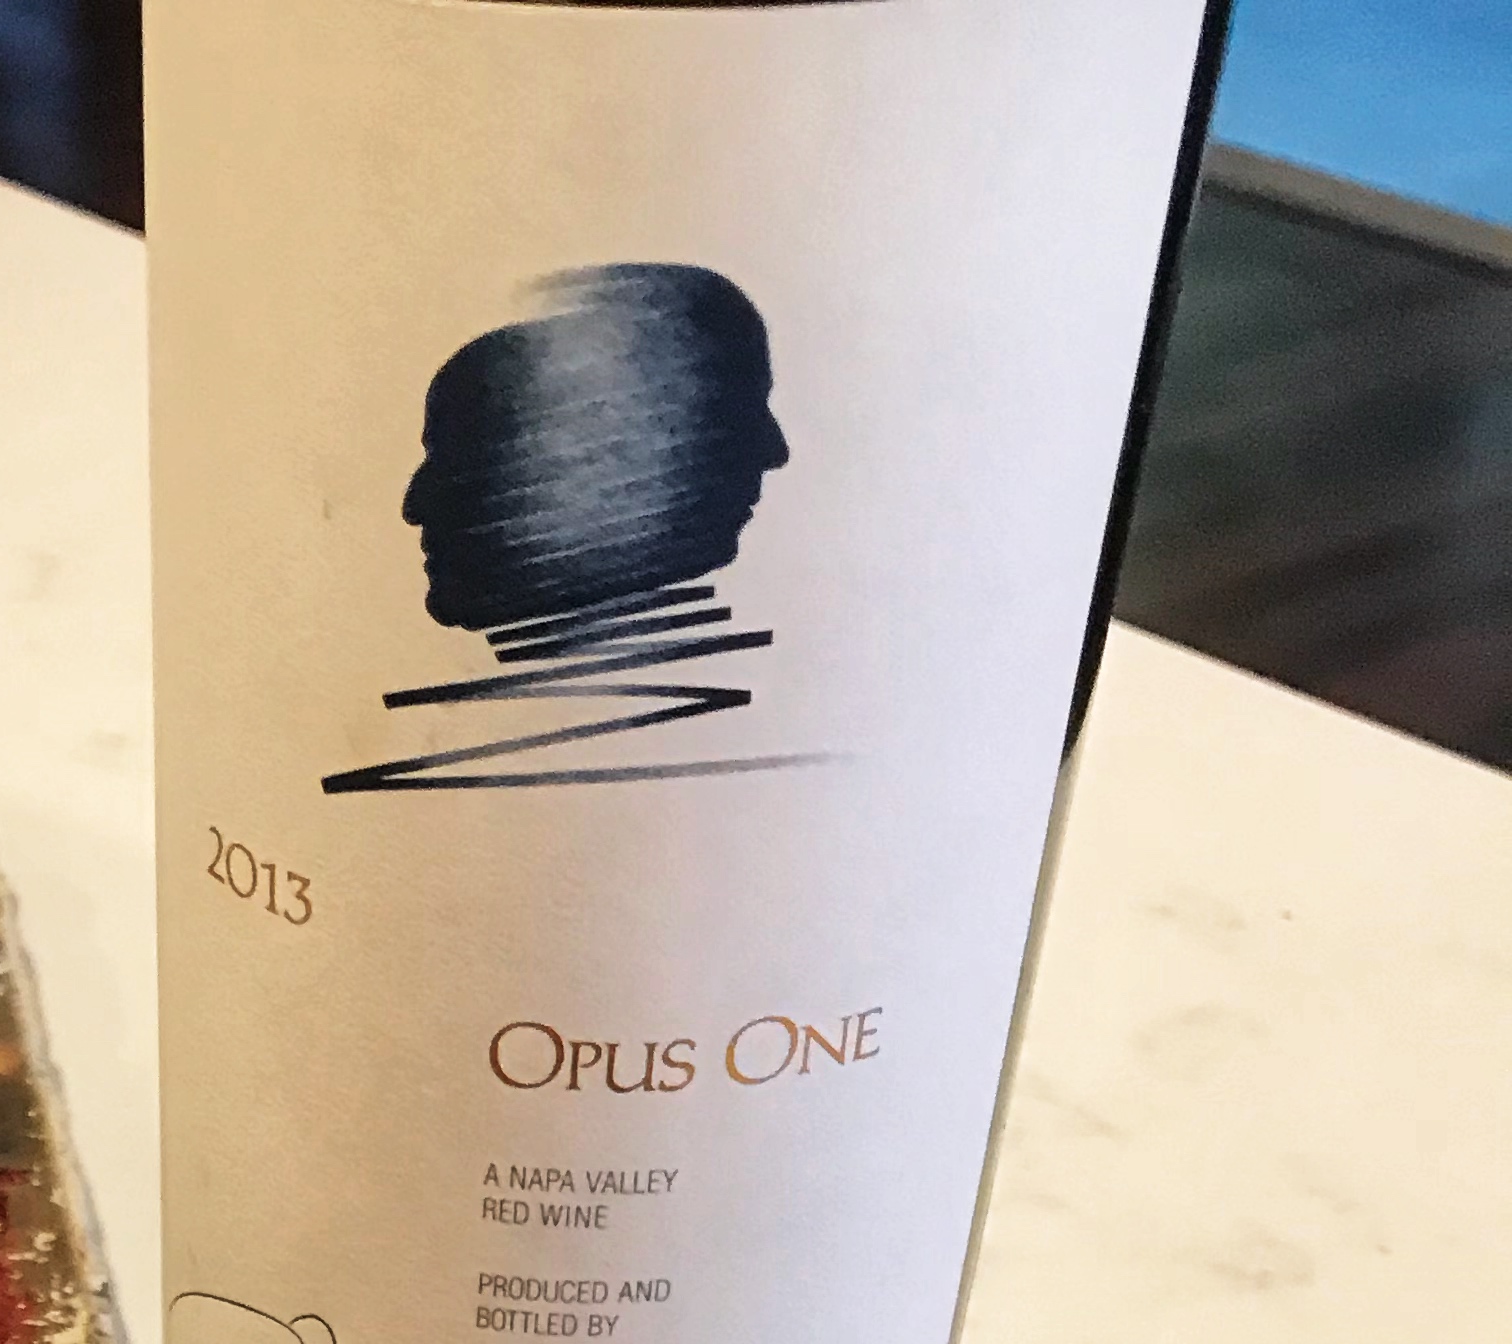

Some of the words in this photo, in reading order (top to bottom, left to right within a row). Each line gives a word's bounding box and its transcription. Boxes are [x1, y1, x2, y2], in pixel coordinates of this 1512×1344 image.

[206, 826, 314, 926] 2013
[488, 1020, 697, 1095] OPUS
[725, 1006, 884, 1086] ONE
[482, 1162, 500, 1187] A
[509, 1164, 576, 1193] NAPA
[586, 1168, 679, 1195] VALLEY
[481, 1196, 530, 1226] RED
[539, 1202, 610, 1230] WINE
[477, 1272, 609, 1305] PRODUCED
[616, 1278, 672, 1304] AND
[475, 1305, 579, 1337] BOTTLED
[586, 1313, 621, 1338] BY
